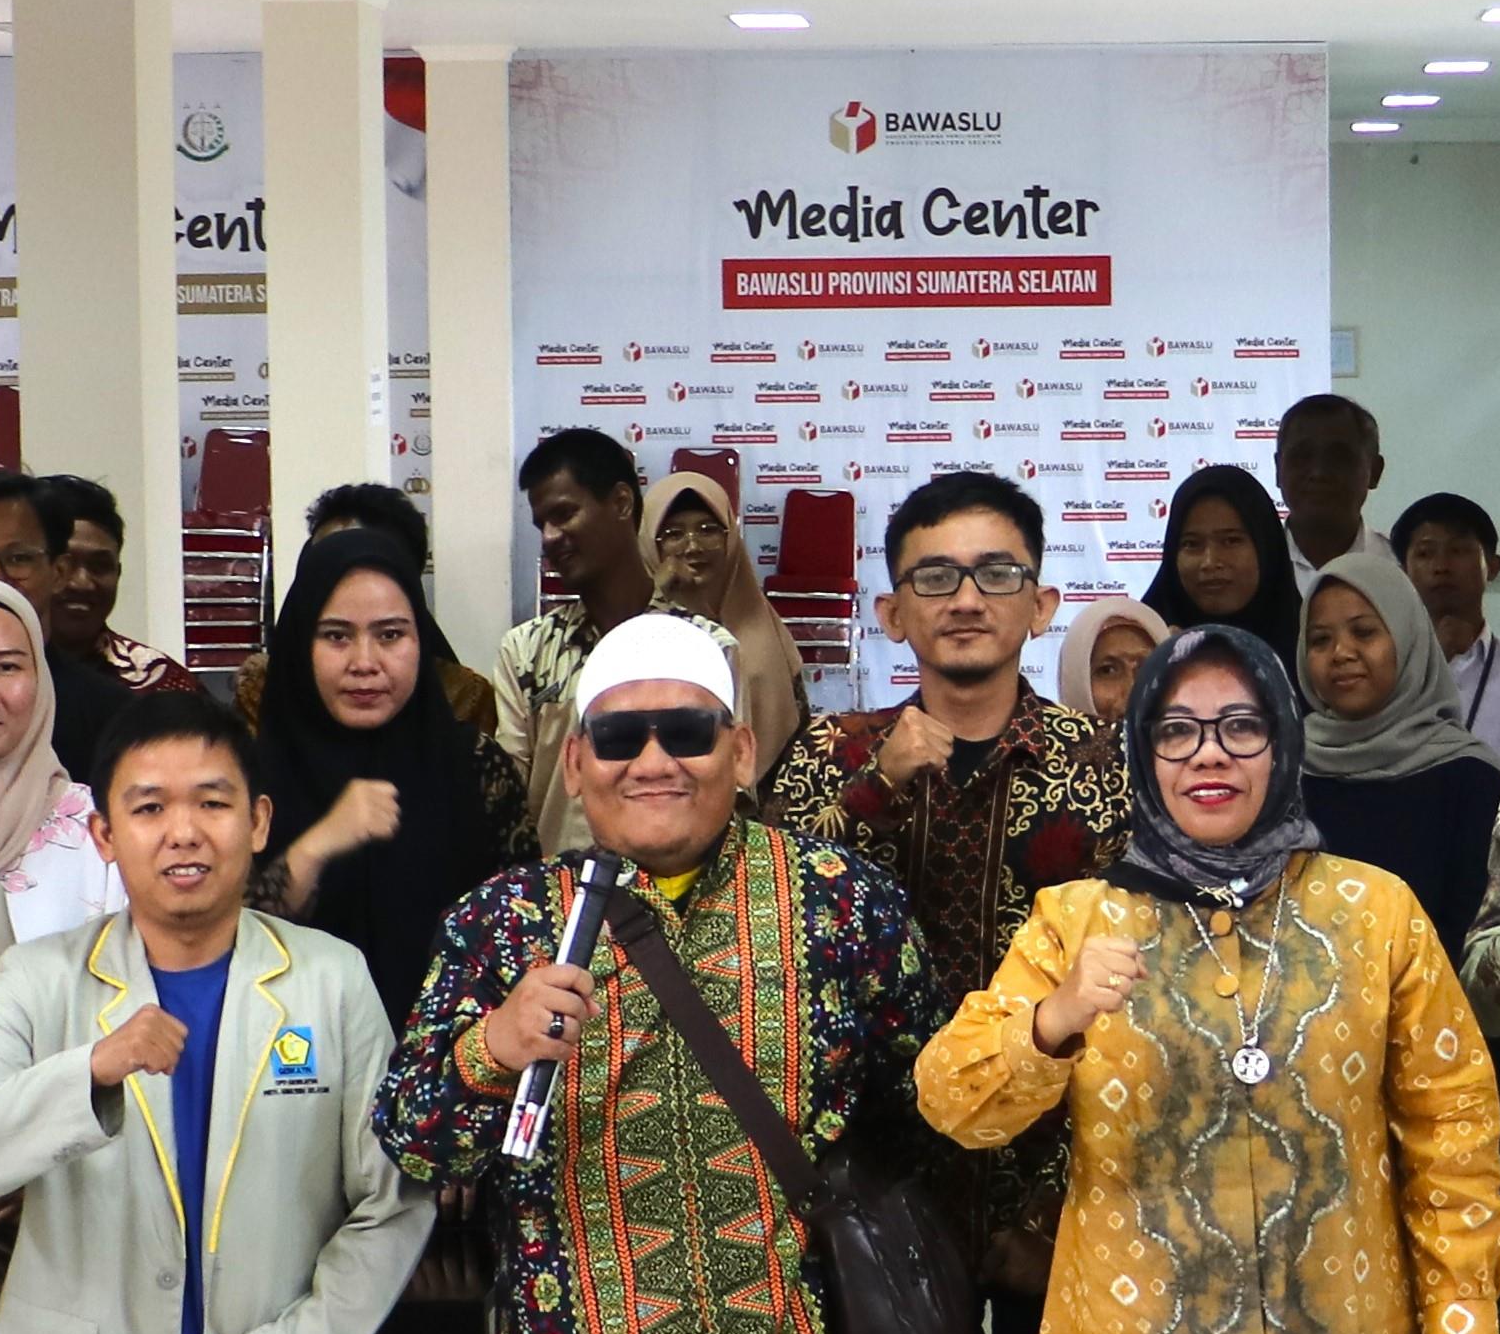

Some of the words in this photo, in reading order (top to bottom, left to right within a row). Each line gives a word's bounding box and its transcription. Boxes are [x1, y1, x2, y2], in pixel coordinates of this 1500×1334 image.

[885, 112, 1001, 132] BAWASLU
[733, 185, 904, 243] Media
[922, 184, 1101, 240] Center
[736, 270, 824, 296] BAWASLU
[828, 269, 912, 295] PROVINSI
[916, 268, 1014, 294] SUMATERA
[1018, 267, 1098, 292] SELATAN
[176, 283, 253, 305] SUMATERA
[712, 341, 741, 352] Media
[744, 341, 773, 351] Center
[887, 339, 915, 350] Media
[918, 338, 948, 352] Center
[993, 342, 1038, 351] BAWASLU
[1062, 338, 1093, 351] Media
[1093, 337, 1122, 348] Center
[1168, 340, 1212, 349] BAWASLU
[1236, 337, 1264, 347] Media
[1267, 336, 1297, 346] Center
[539, 344, 567, 353] Media
[570, 343, 599, 353] Center
[644, 345, 689, 354] BAWASLU
[819, 343, 863, 353] BAWASLU
[193, 356, 233, 368] Center
[583, 383, 611, 393] Media
[614, 382, 644, 393] Center
[757, 381, 785, 392] Media
[788, 381, 818, 391] Center
[863, 383, 908, 393] BAWASLU
[932, 380, 960, 390] Media
[963, 379, 992, 389] Center
[1038, 382, 1082, 391] BAWASLU
[1106, 378, 1134, 388] Media
[1137, 378, 1166, 388] Center
[1212, 380, 1256, 390] BAWASLU
[688, 385, 733, 395] BAWASLU
[201, 395, 239, 407] Media
[714, 423, 742, 433] Media
[745, 421, 775, 432] Center
[820, 424, 864, 434] BAWASLU
[888, 420, 916, 431] Media
[919, 420, 949, 431] Center
[994, 423, 1039, 432] BAWASLU
[1063, 419, 1091, 429] Media
[1094, 418, 1124, 429] Center
[1169, 421, 1213, 430] BAWASLU
[646, 426, 690, 435] BAWASLU
[758, 462, 786, 473] Media
[789, 462, 819, 472] Center
[933, 461, 964, 473] Media
[1039, 463, 1083, 472] BAWASLU
[1107, 459, 1135, 469] Media
[1138, 458, 1167, 469] Center
[864, 465, 909, 474] BAWASLU
[1064, 500, 1092, 510] Media
[1095, 499, 1124, 509] Center
[1066, 581, 1093, 591] Media
[1096, 580, 1126, 590] Center
